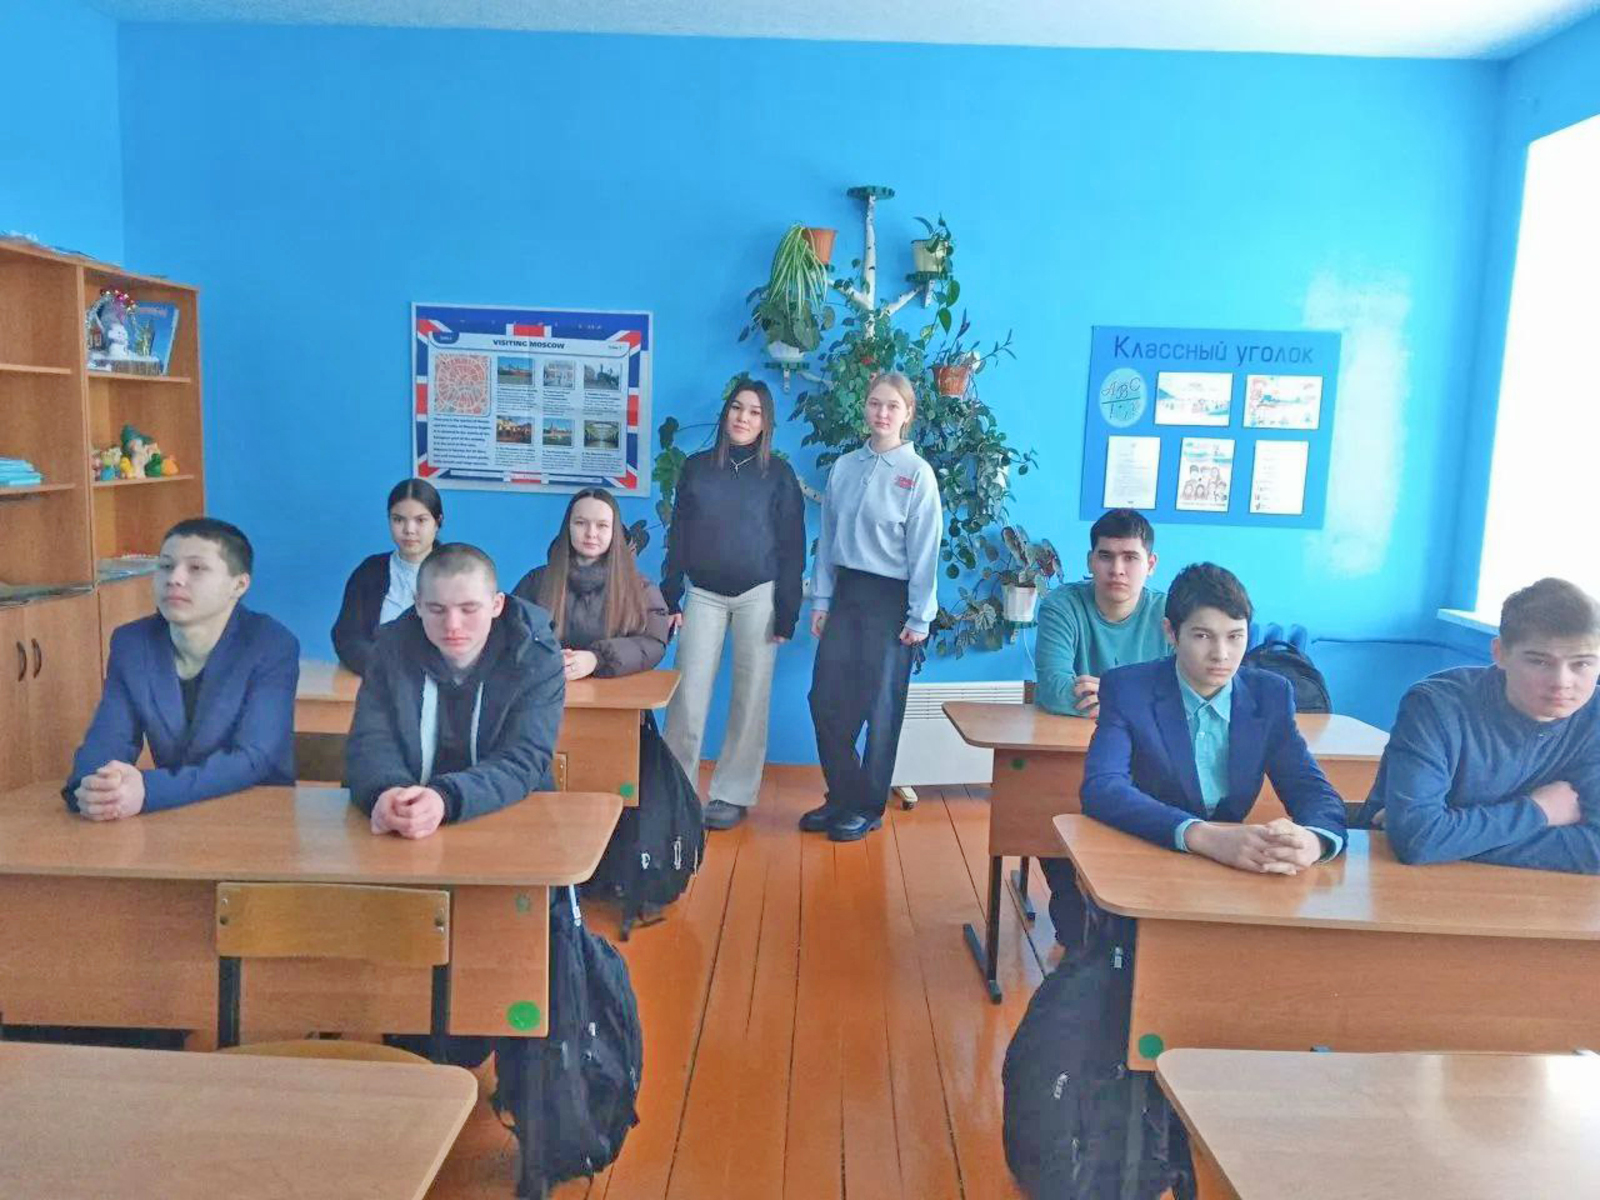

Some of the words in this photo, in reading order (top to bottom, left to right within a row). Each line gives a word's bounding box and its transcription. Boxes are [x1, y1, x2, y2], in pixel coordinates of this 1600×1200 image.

[493, 339, 528, 348] VISITING
[529, 340, 565, 350] MOSCOW
[1114, 335, 1227, 362] Классный
[1236, 345, 1314, 367] уголок
